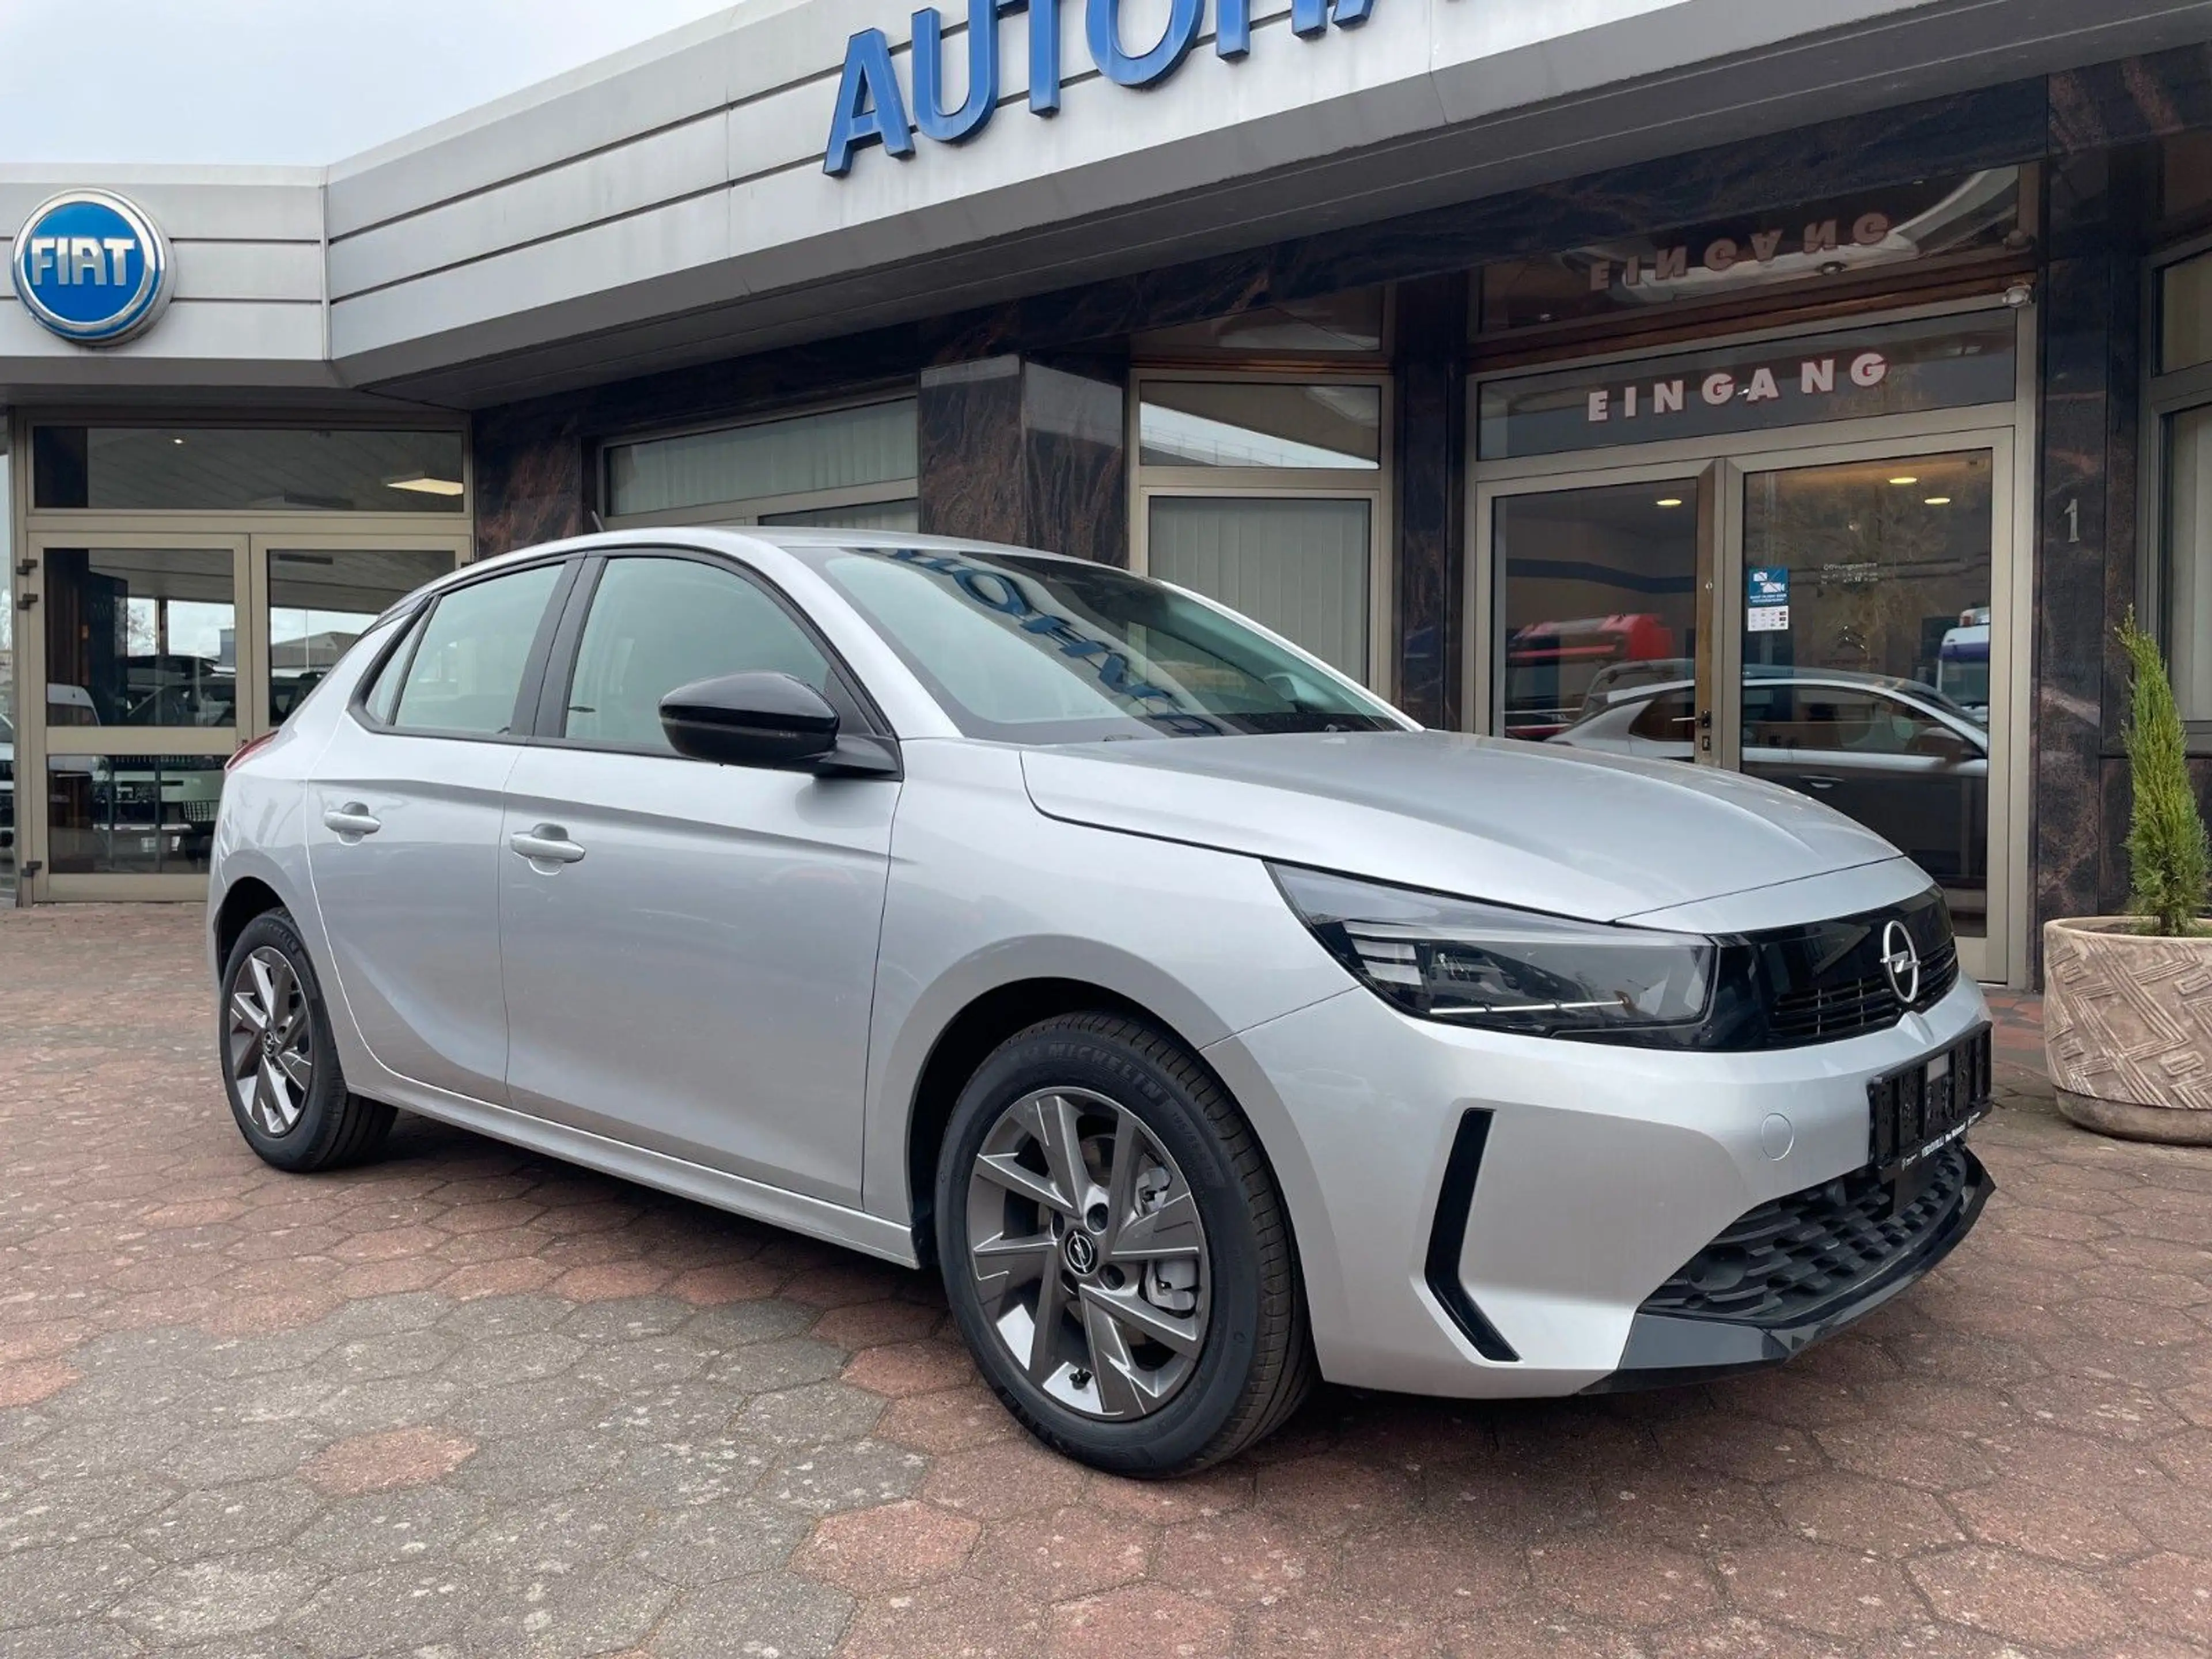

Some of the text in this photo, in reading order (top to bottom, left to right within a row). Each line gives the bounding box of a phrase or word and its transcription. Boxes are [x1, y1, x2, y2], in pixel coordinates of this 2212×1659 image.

[823, 0, 1373, 177] AUTO
[31, 236, 136, 286] FIAT
[1588, 352, 1888, 422] EINGANG
[2063, 498, 2080, 543] 1
[1048, 1041, 1165, 1099] MICHELIN
